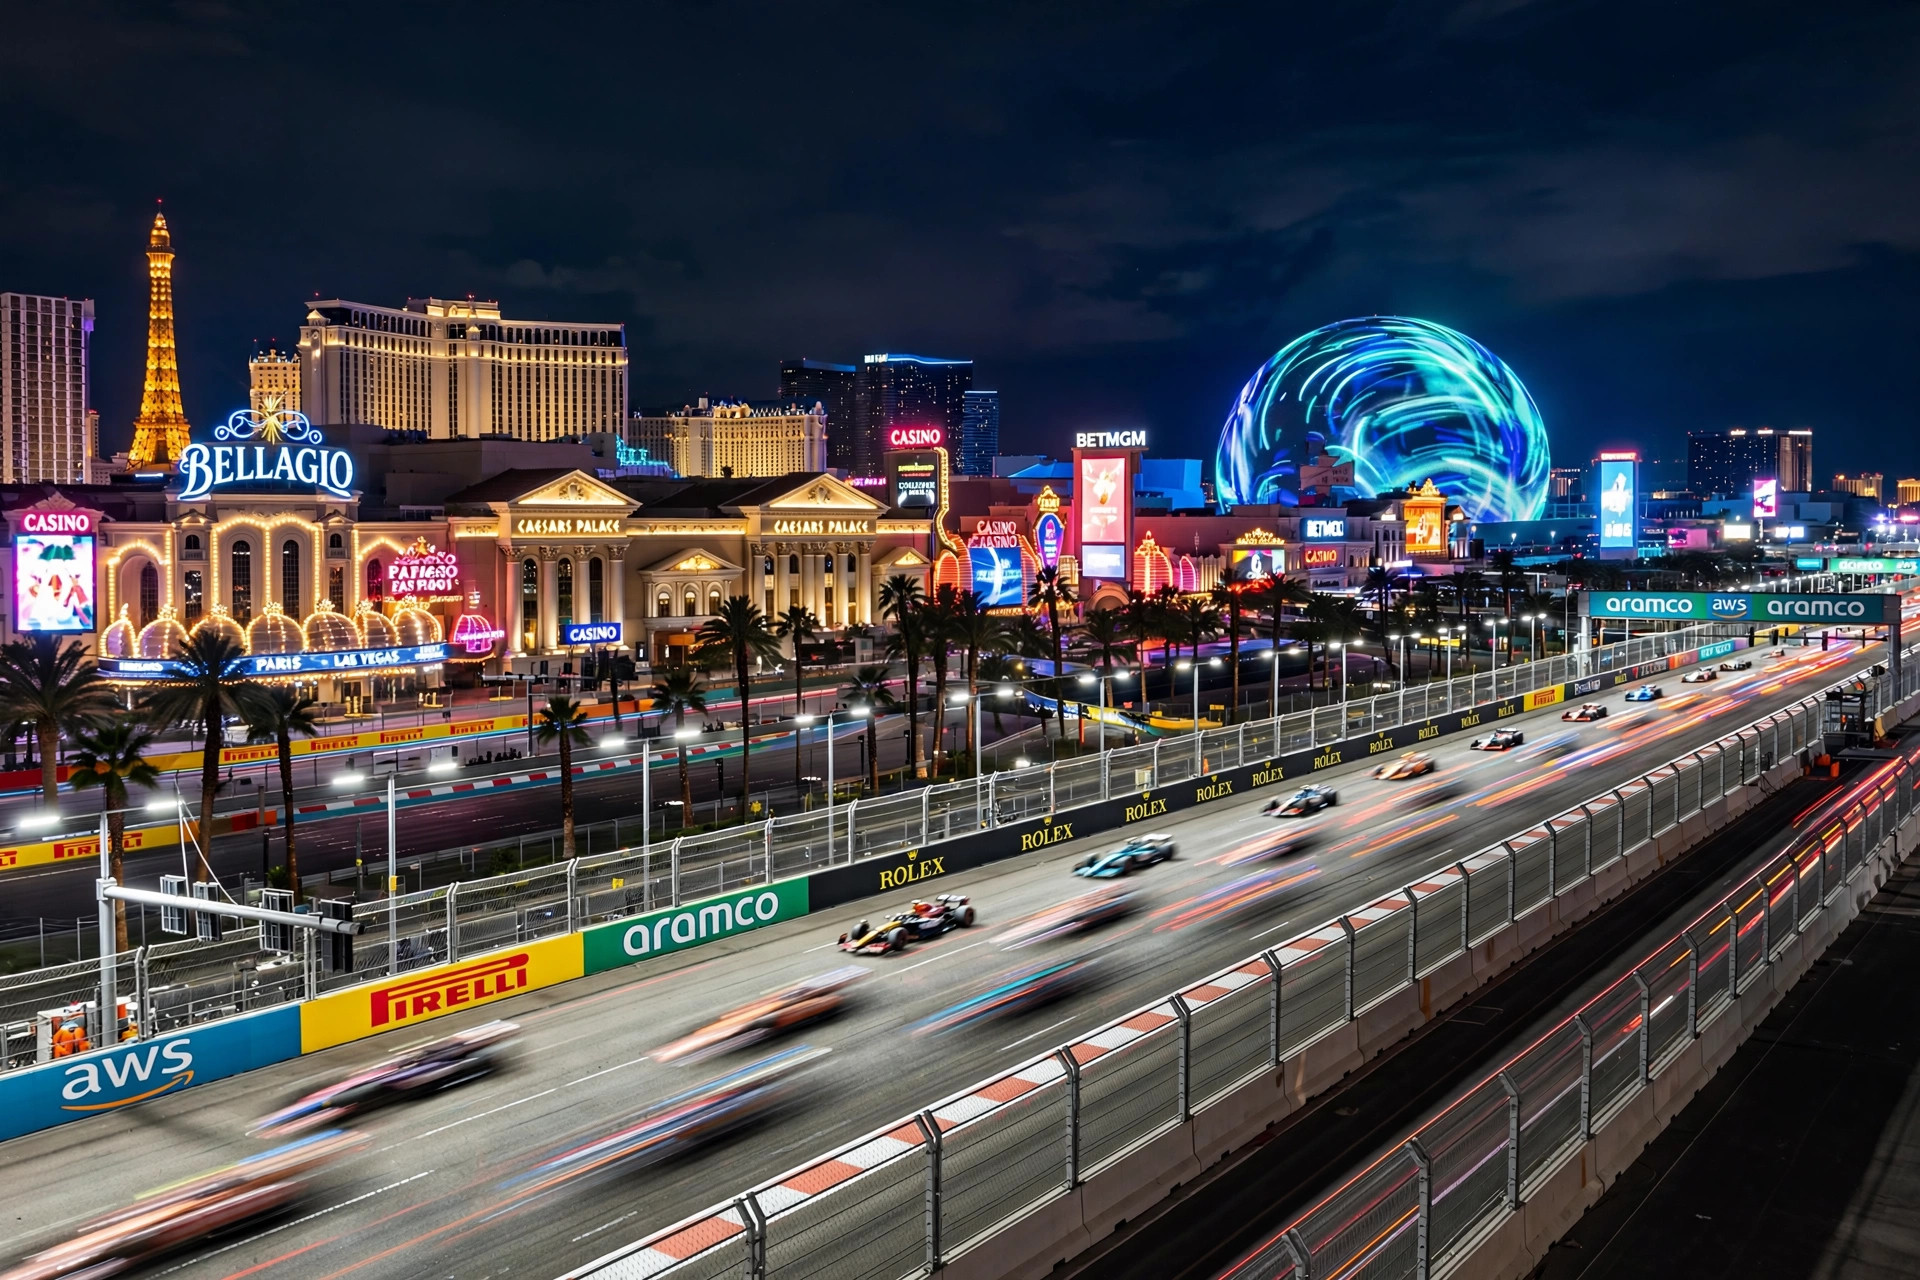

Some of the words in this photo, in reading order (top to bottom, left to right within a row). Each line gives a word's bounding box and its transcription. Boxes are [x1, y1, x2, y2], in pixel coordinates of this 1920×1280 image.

[891, 429, 941, 445] CASINO
[1076, 431, 1147, 448] BETMGM
[176, 443, 355, 500] BELLAGIO
[24, 513, 90, 532] CASINO
[518, 519, 572, 534] CAESARS
[576, 519, 620, 533] PALACE
[774, 519, 824, 534] CAESARS
[828, 520, 869, 533] PALACE
[977, 520, 1017, 535] CASINO
[1606, 598, 1692, 613] aramco
[1712, 598, 1747, 611] aws
[1767, 599, 1865, 616] aramco
[570, 626, 617, 642] CASINO
[256, 657, 302, 671] PARIS
[334, 654, 358, 667] LAS
[361, 651, 400, 665] VEGAS
[1418, 725, 1439, 740] ROLEX
[1370, 737, 1394, 753] ROLEX
[1314, 751, 1342, 770] ROLEX
[1252, 767, 1284, 787] ROLEX
[1197, 780, 1233, 802] ROLEX
[1125, 798, 1167, 822] ROLEX
[1021, 822, 1073, 850] ROLEX
[880, 856, 946, 890] ROLEX
[622, 891, 779, 956] aramco
[371, 953, 529, 1027] PIRELLI
[61, 1038, 193, 1101] aws
